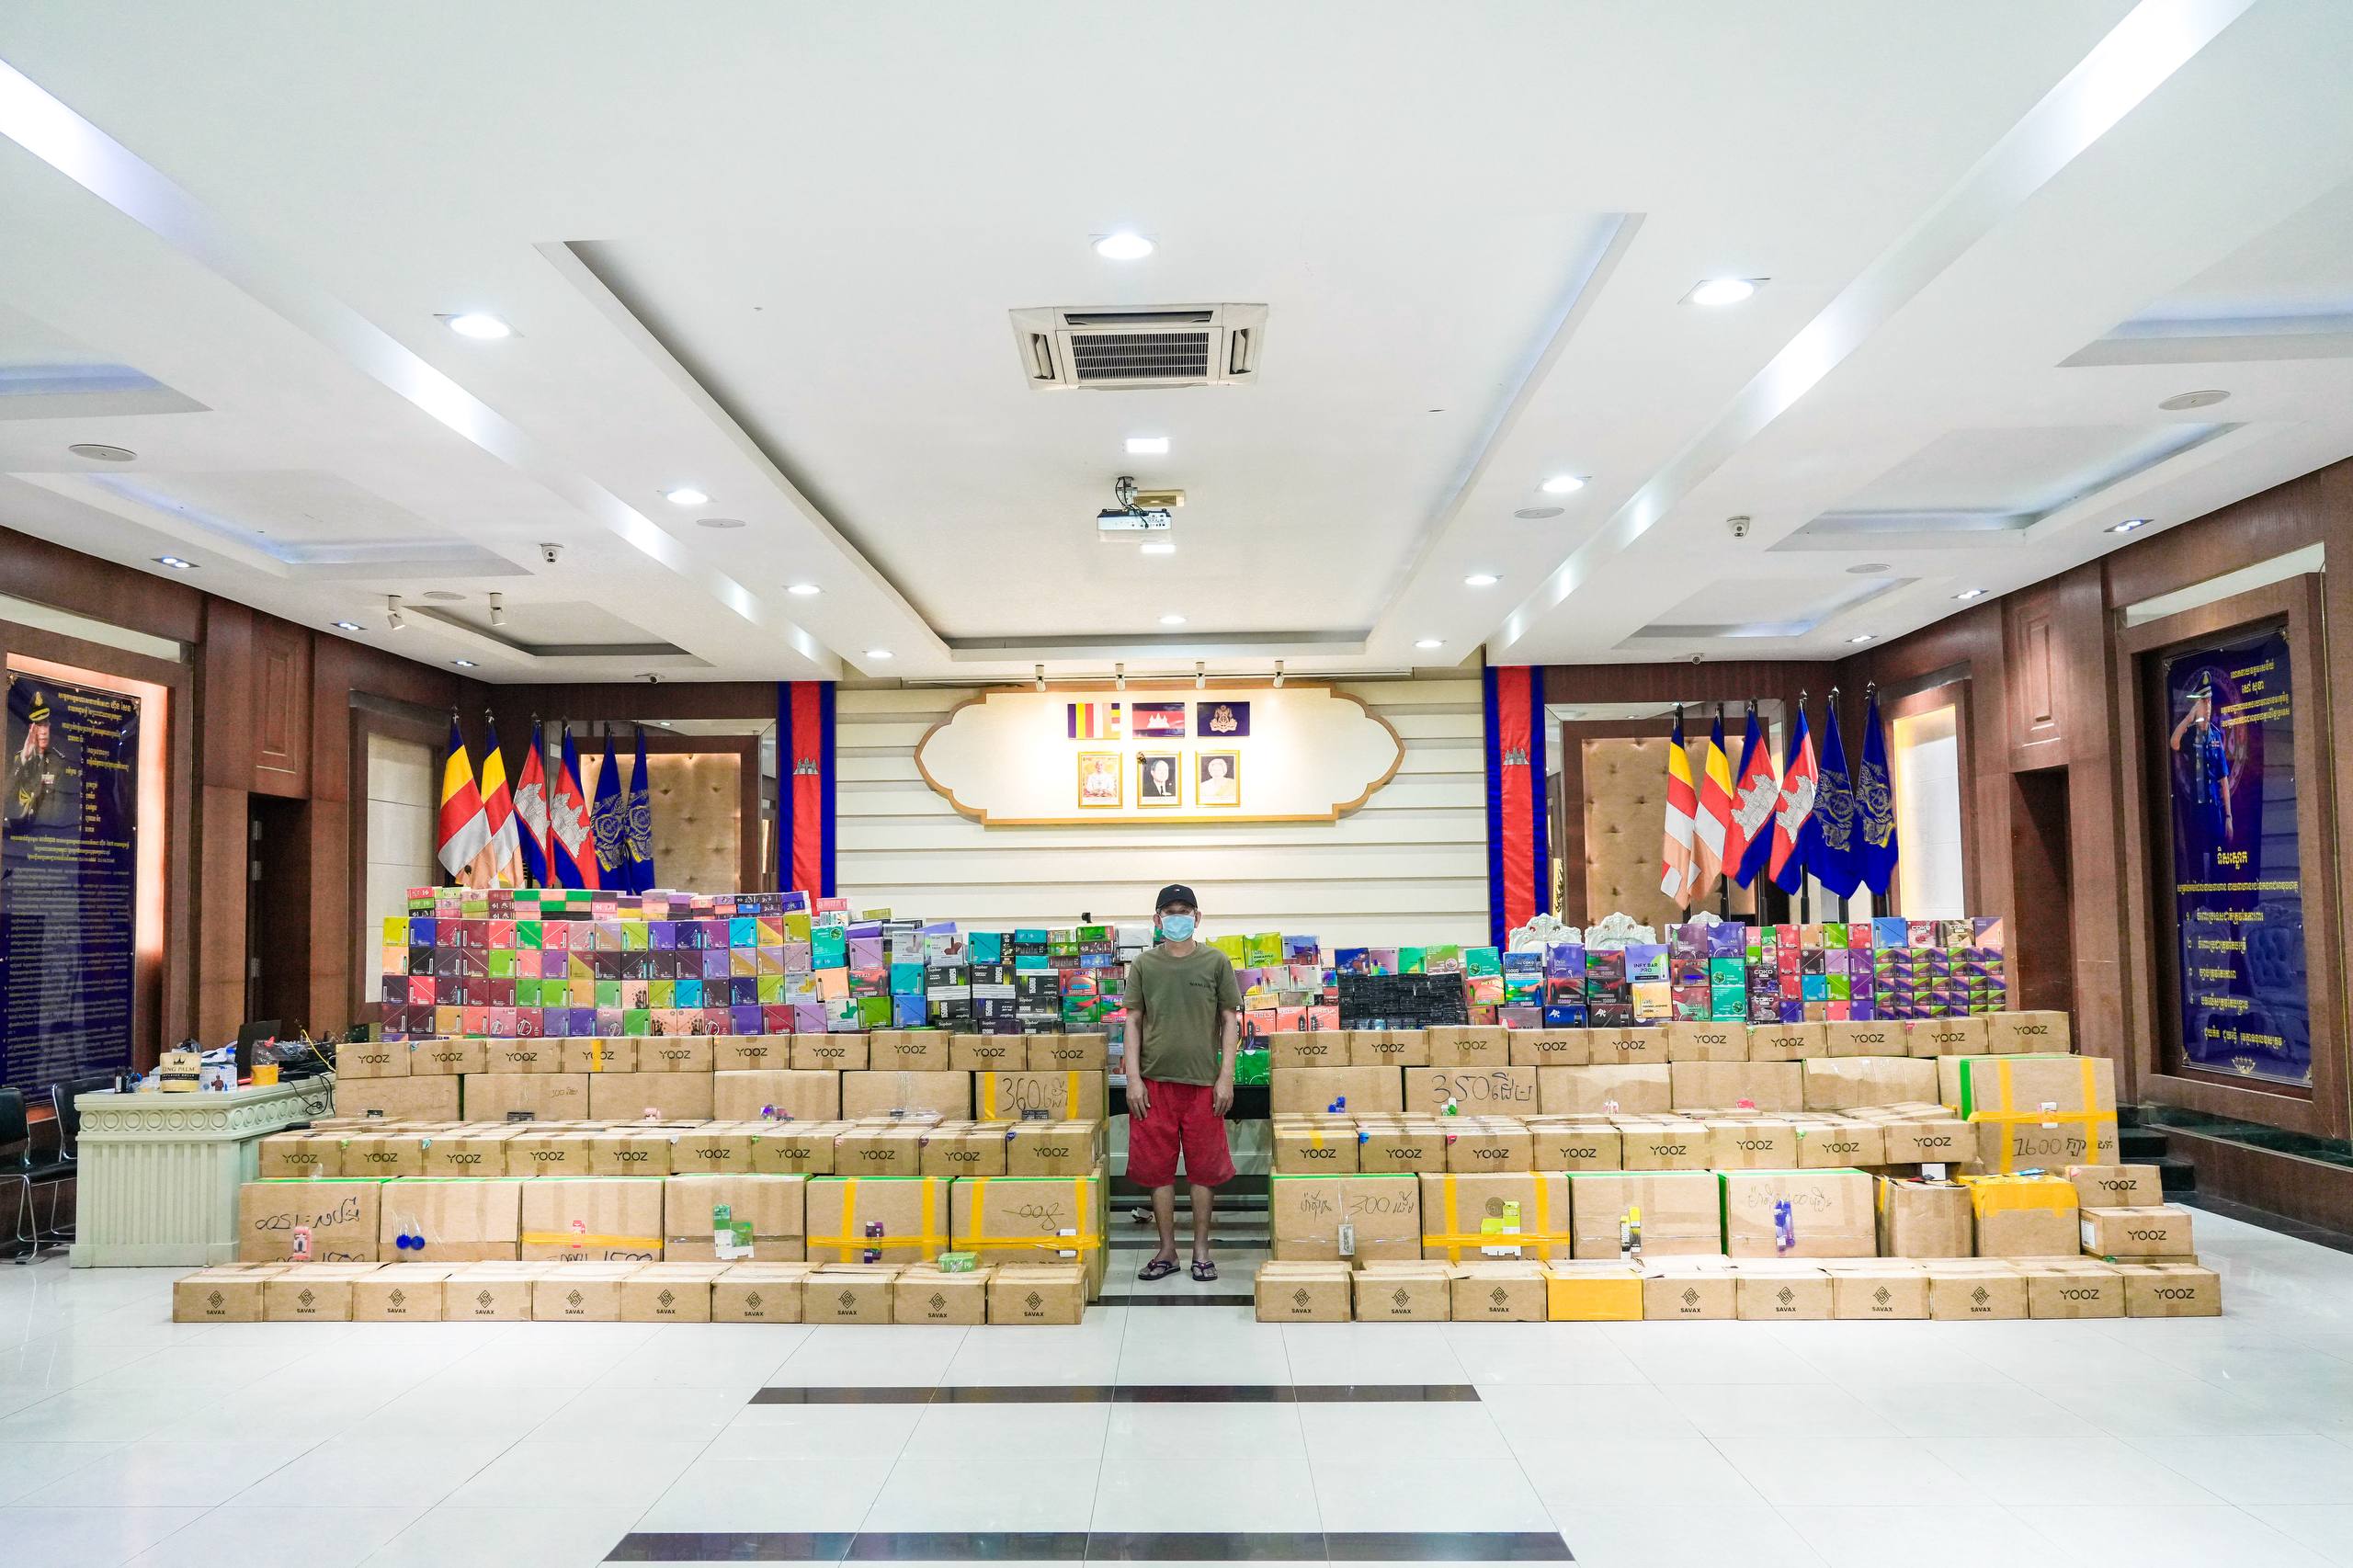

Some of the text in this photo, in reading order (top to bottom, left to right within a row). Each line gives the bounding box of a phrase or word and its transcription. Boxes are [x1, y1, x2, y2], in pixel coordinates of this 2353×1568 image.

[2014, 1026, 2048, 1035] YOOZ
[1694, 1035, 1726, 1043] YOOZ
[1851, 1034, 1884, 1043] YOOZ
[1931, 1033, 1965, 1042] YOOZ
[1454, 1041, 1487, 1051] YOOZ
[1534, 1042, 1566, 1051] YOOZ
[1612, 1041, 1645, 1051] YOOZ
[1771, 1038, 1804, 1047] YOOZ
[736, 1048, 767, 1056] YOOZ
[813, 1049, 845, 1057] YOOZ
[894, 1045, 926, 1054] YOOZ
[972, 1049, 1005, 1057] YOOZ
[1294, 1046, 1327, 1055] YOOZ
[1371, 1044, 1404, 1053] YOOZ
[358, 1055, 389, 1063] YOOZ
[432, 1052, 462, 1062] YOOZ
[506, 1052, 537, 1062] YOOZ
[583, 1051, 614, 1061] YOZ
[659, 1051, 690, 1059] YOOZ
[1051, 1050, 1084, 1059] YOOZ
[1432, 1075, 1490, 1103] 350
[1003, 1077, 1040, 1111] 360
[1736, 1141, 1772, 1150] YOOZ
[1914, 1137, 1951, 1147] YOOZ
[1650, 1146, 1686, 1155] YOOZ
[1823, 1142, 1859, 1153] YOOZ
[2013, 1138, 2061, 1156] 1600
[530, 1152, 564, 1161] YOOZ
[614, 1152, 647, 1161] YOOZ
[696, 1149, 730, 1159] YOOZ
[776, 1149, 810, 1158] YOOZ
[860, 1151, 894, 1160] YOOZ
[945, 1152, 980, 1161] YOOZ
[1033, 1148, 1069, 1157] YOOZ
[1301, 1149, 1336, 1158] YOOZ
[1386, 1149, 1422, 1158] YOOZ
[1473, 1149, 1508, 1158] YOOZ
[1560, 1149, 1596, 1158] YOOZ
[282, 1153, 317, 1164] YOOZ
[364, 1153, 397, 1162] YOOZ
[447, 1154, 481, 1164] YOOZ
[2098, 1180, 2137, 1190] YOOZ
[1349, 1195, 1391, 1216] 300
[2128, 1231, 2166, 1241] YOOZ
[2060, 1290, 2099, 1300] YOOZ
[2154, 1289, 2194, 1299] YOOZ
